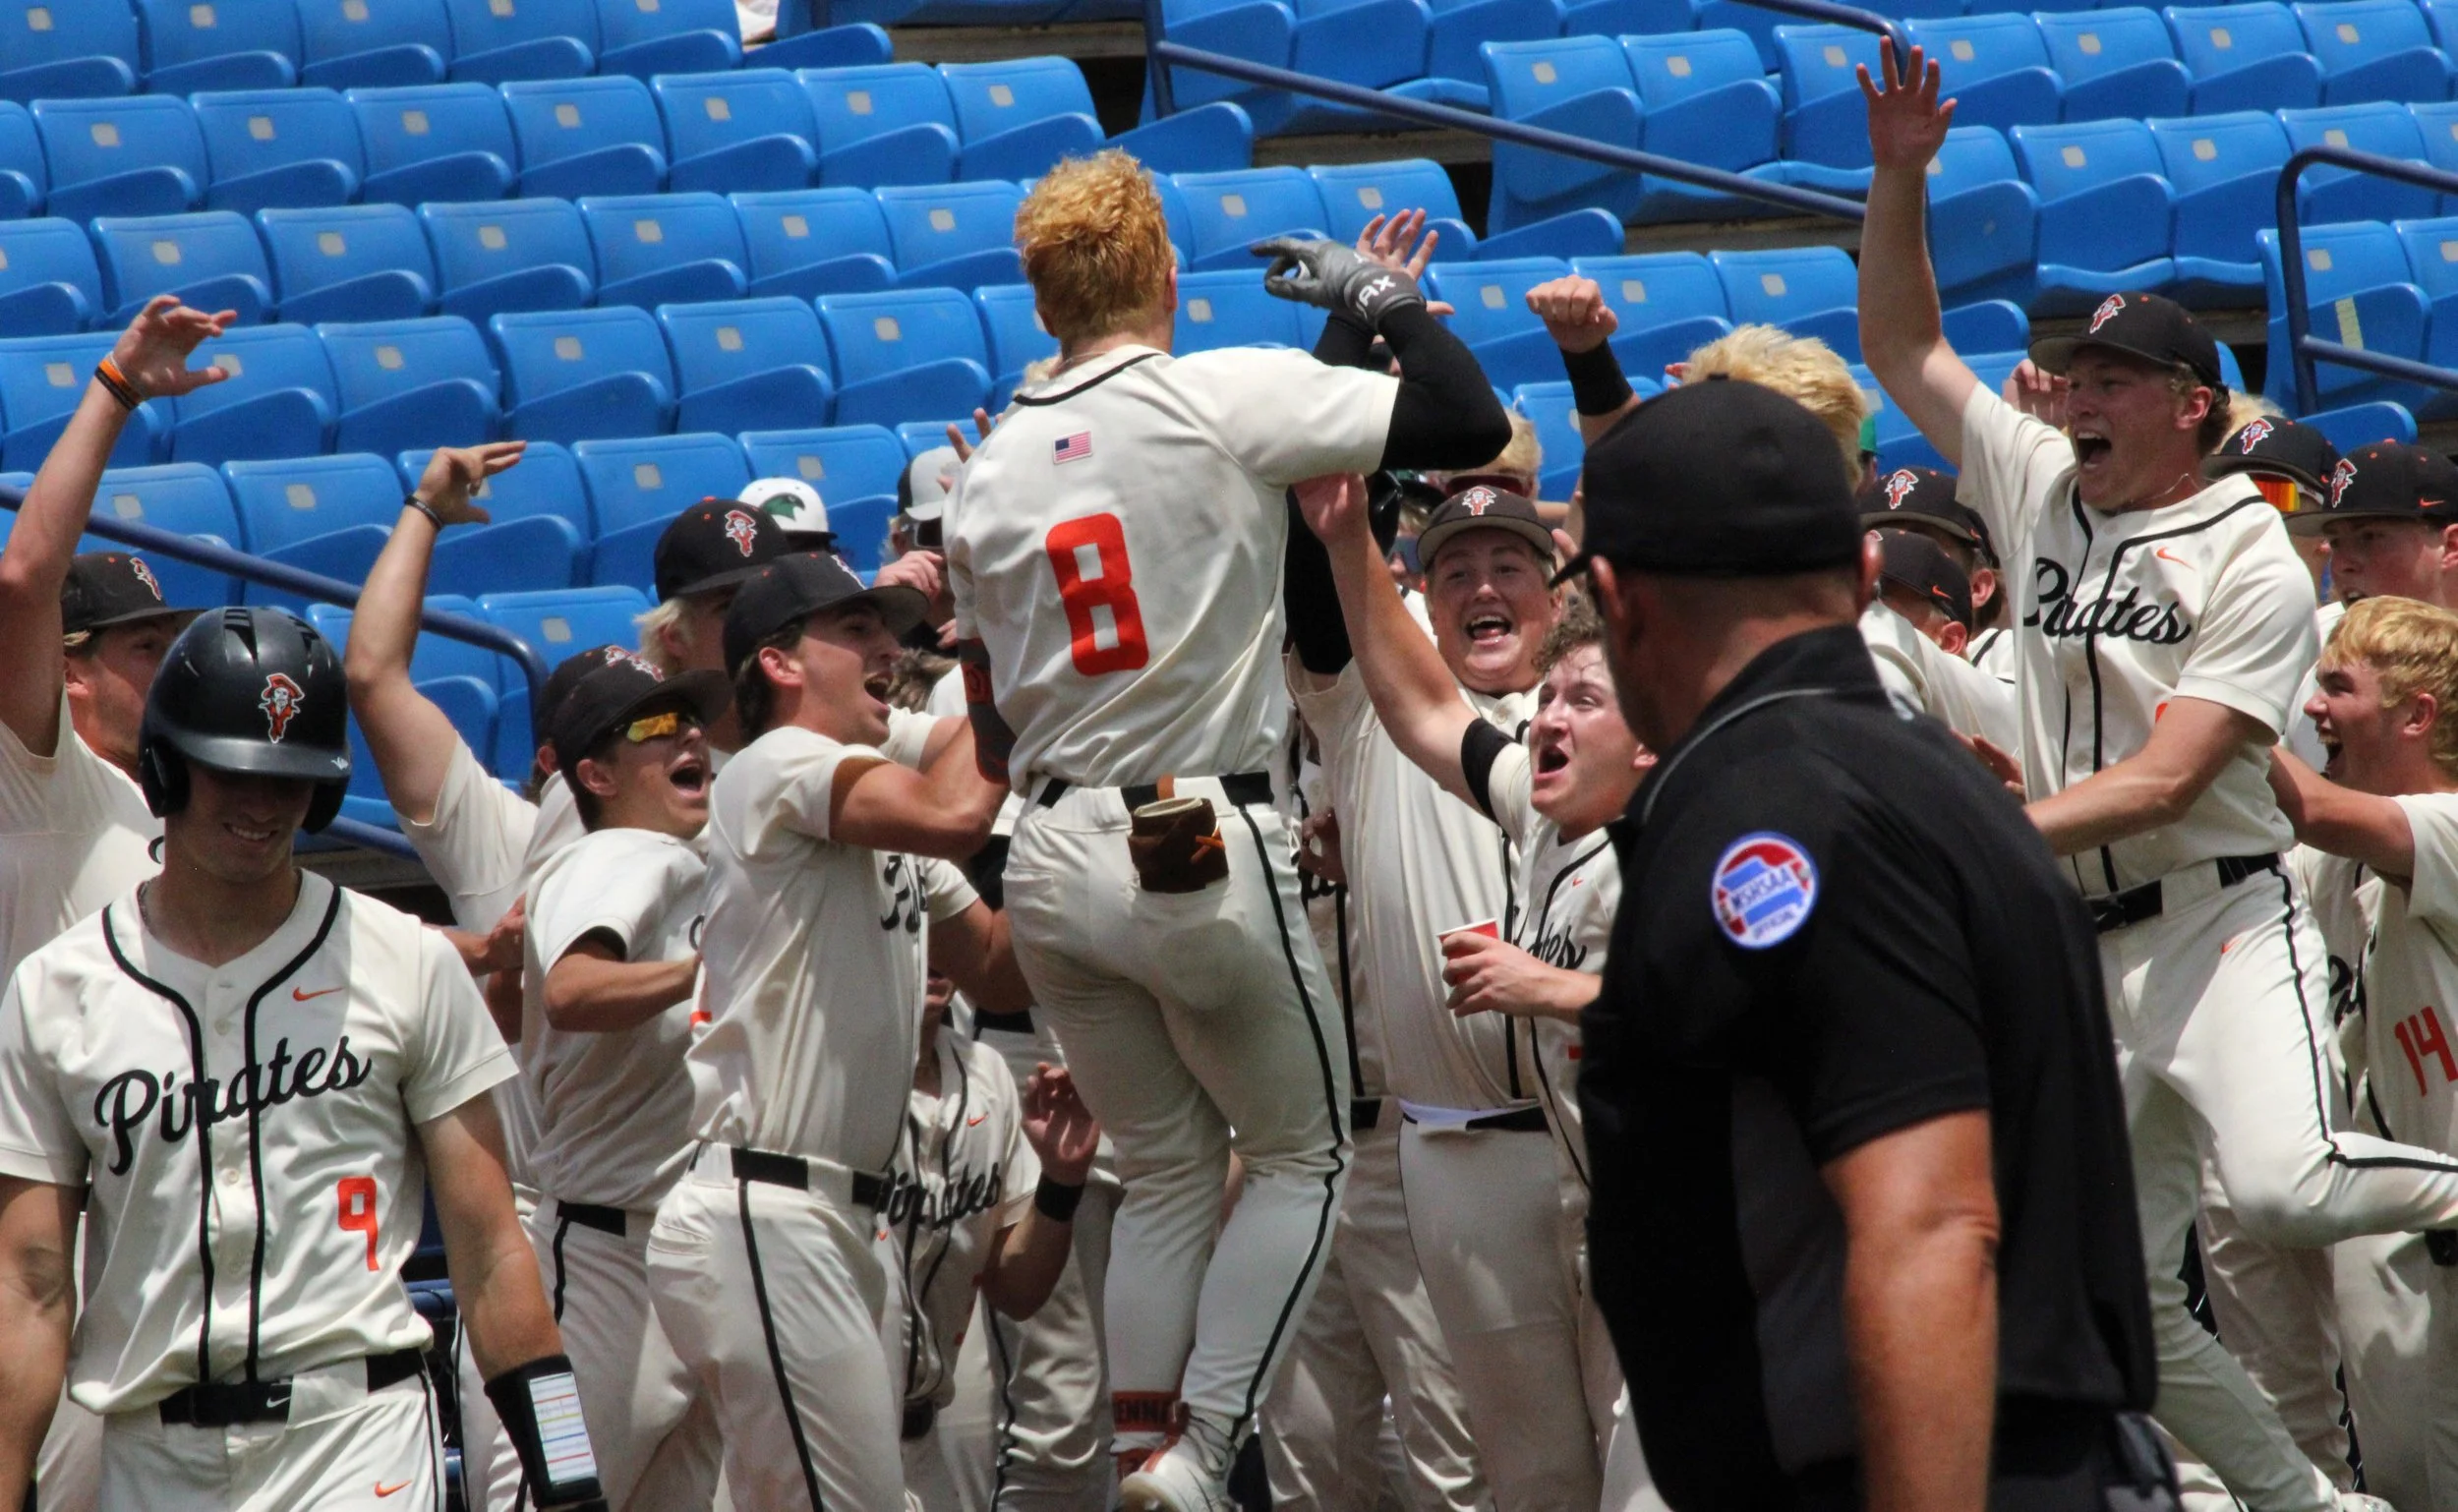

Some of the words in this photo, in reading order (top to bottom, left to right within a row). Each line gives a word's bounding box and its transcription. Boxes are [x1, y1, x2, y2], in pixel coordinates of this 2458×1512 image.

[1045, 512, 1149, 676] 8
[94, 1035, 372, 1176] Pirates
[2395, 1006, 2458, 1097] 14
[337, 1176, 379, 1271] 9
